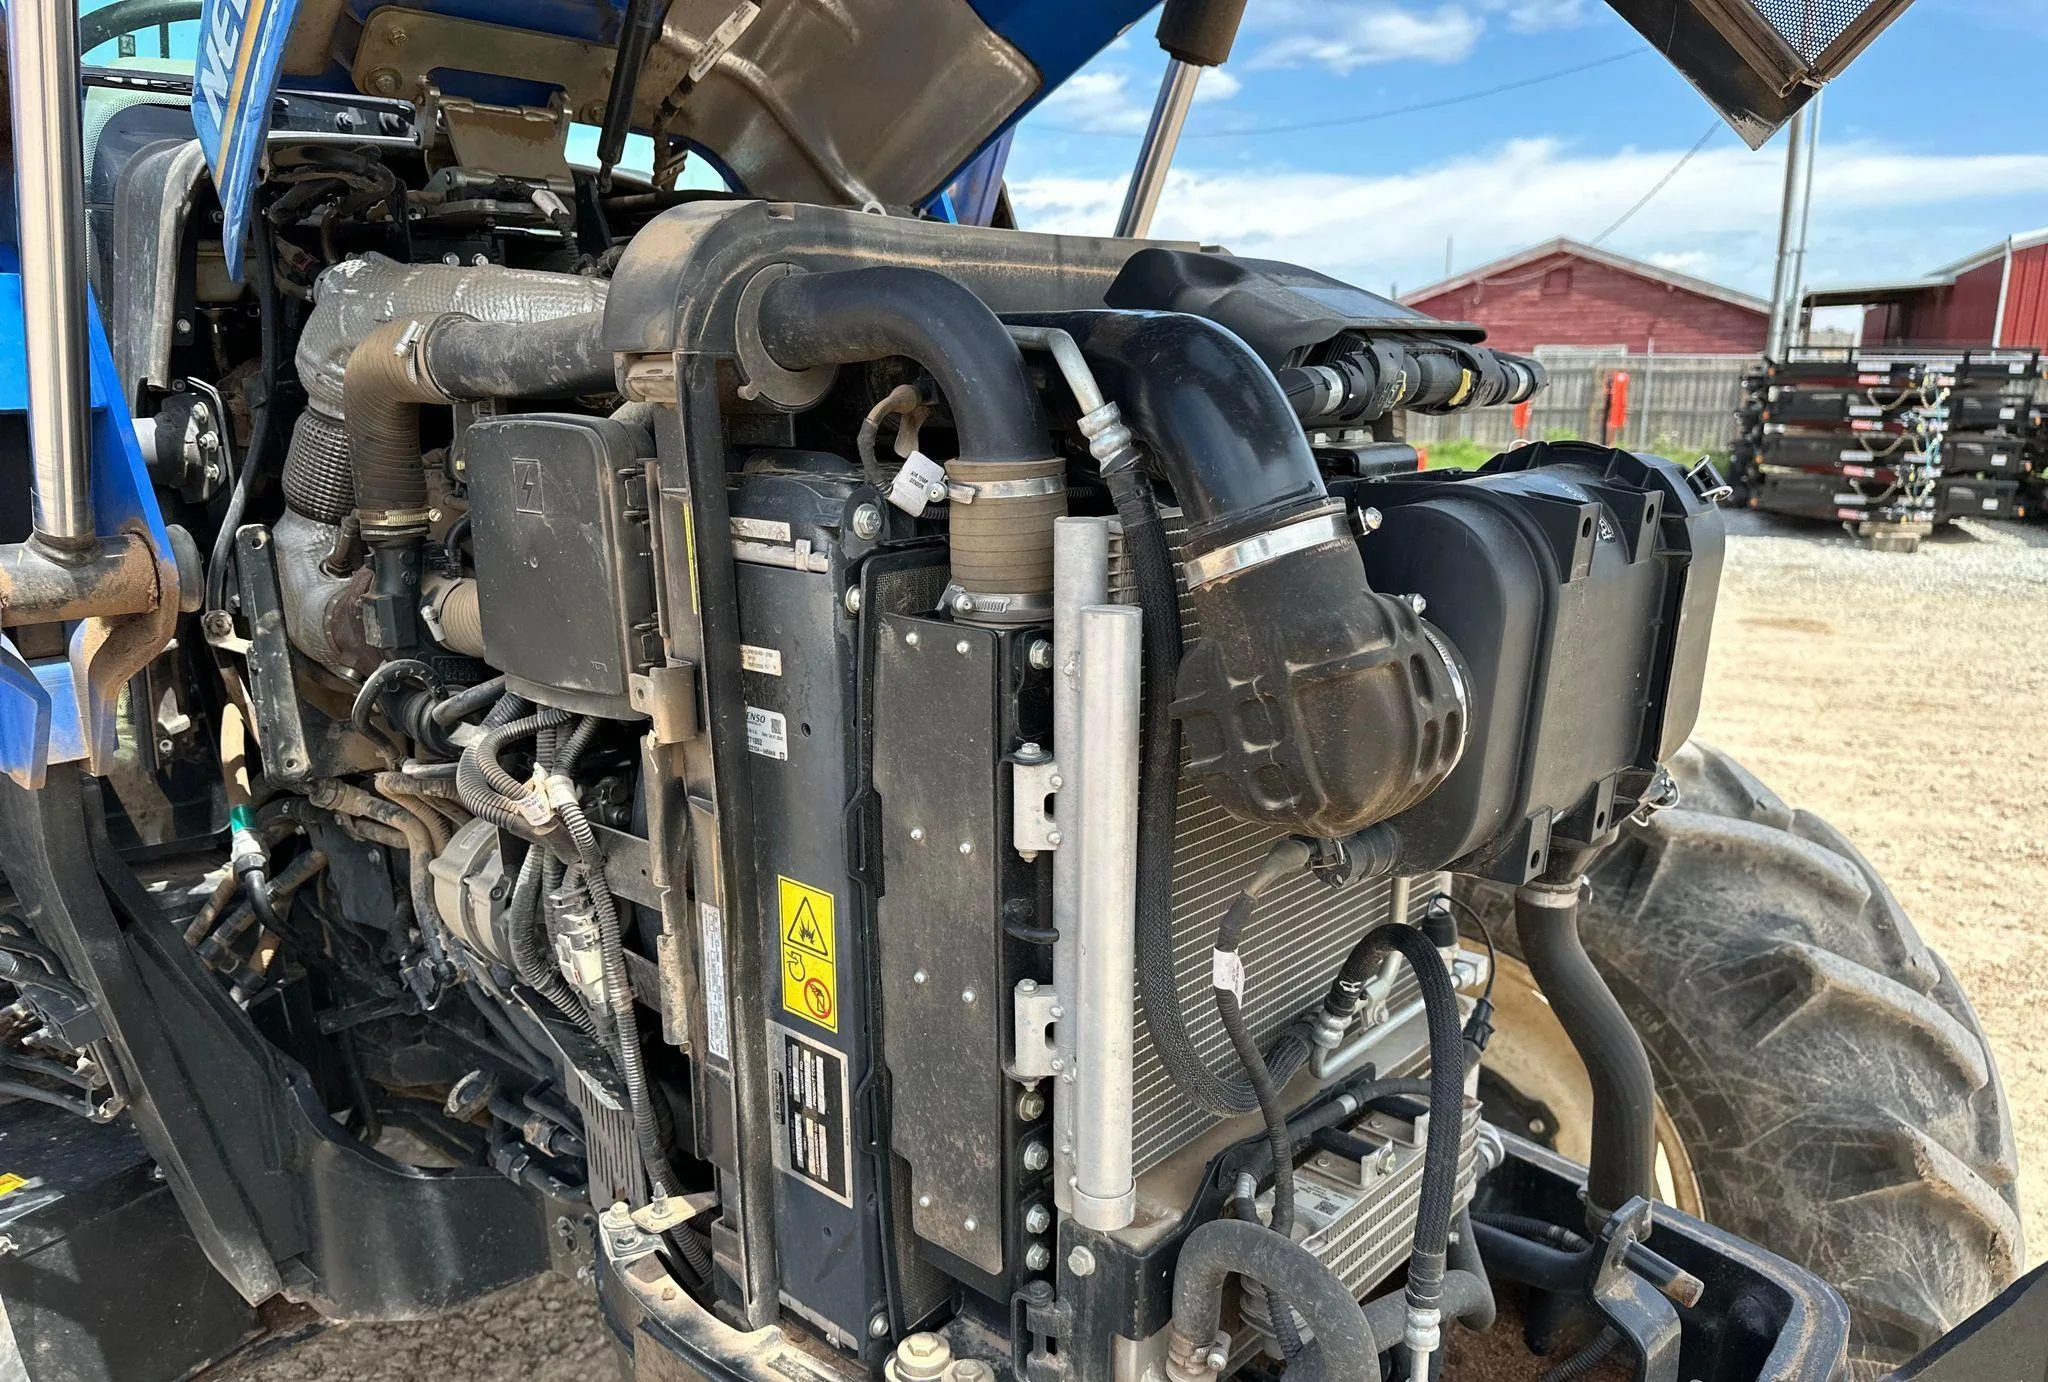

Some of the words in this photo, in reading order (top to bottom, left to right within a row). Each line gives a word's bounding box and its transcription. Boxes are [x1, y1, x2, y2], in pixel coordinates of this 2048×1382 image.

[909, 478, 924, 489] SENSOR
[918, 475, 928, 484] TEMP
[747, 711, 766, 724] ENSO
